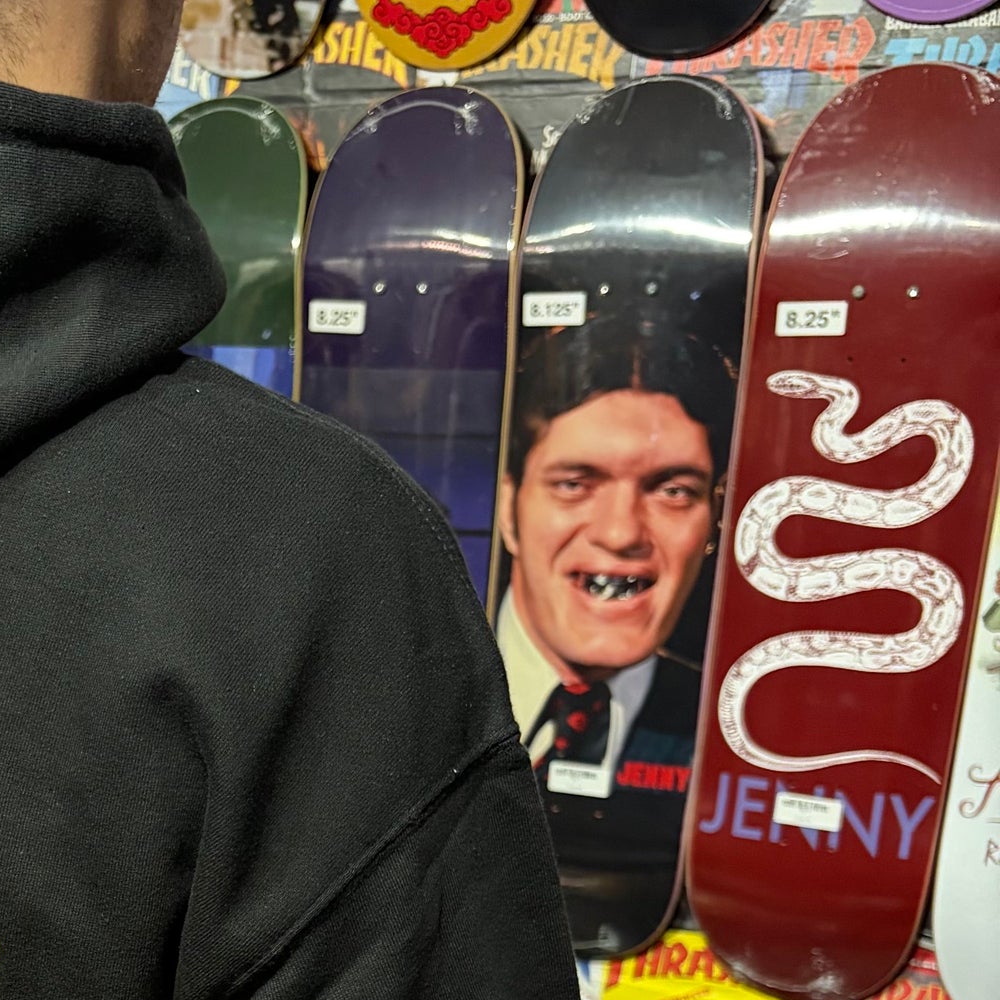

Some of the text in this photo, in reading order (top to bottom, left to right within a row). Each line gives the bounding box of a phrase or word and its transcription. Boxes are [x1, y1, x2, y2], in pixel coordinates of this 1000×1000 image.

[316, 309, 359, 326] 8.25"
[530, 302, 580, 317] 8.125"
[785, 309, 841, 329] 8.25"
[616, 761, 693, 793] JENNY
